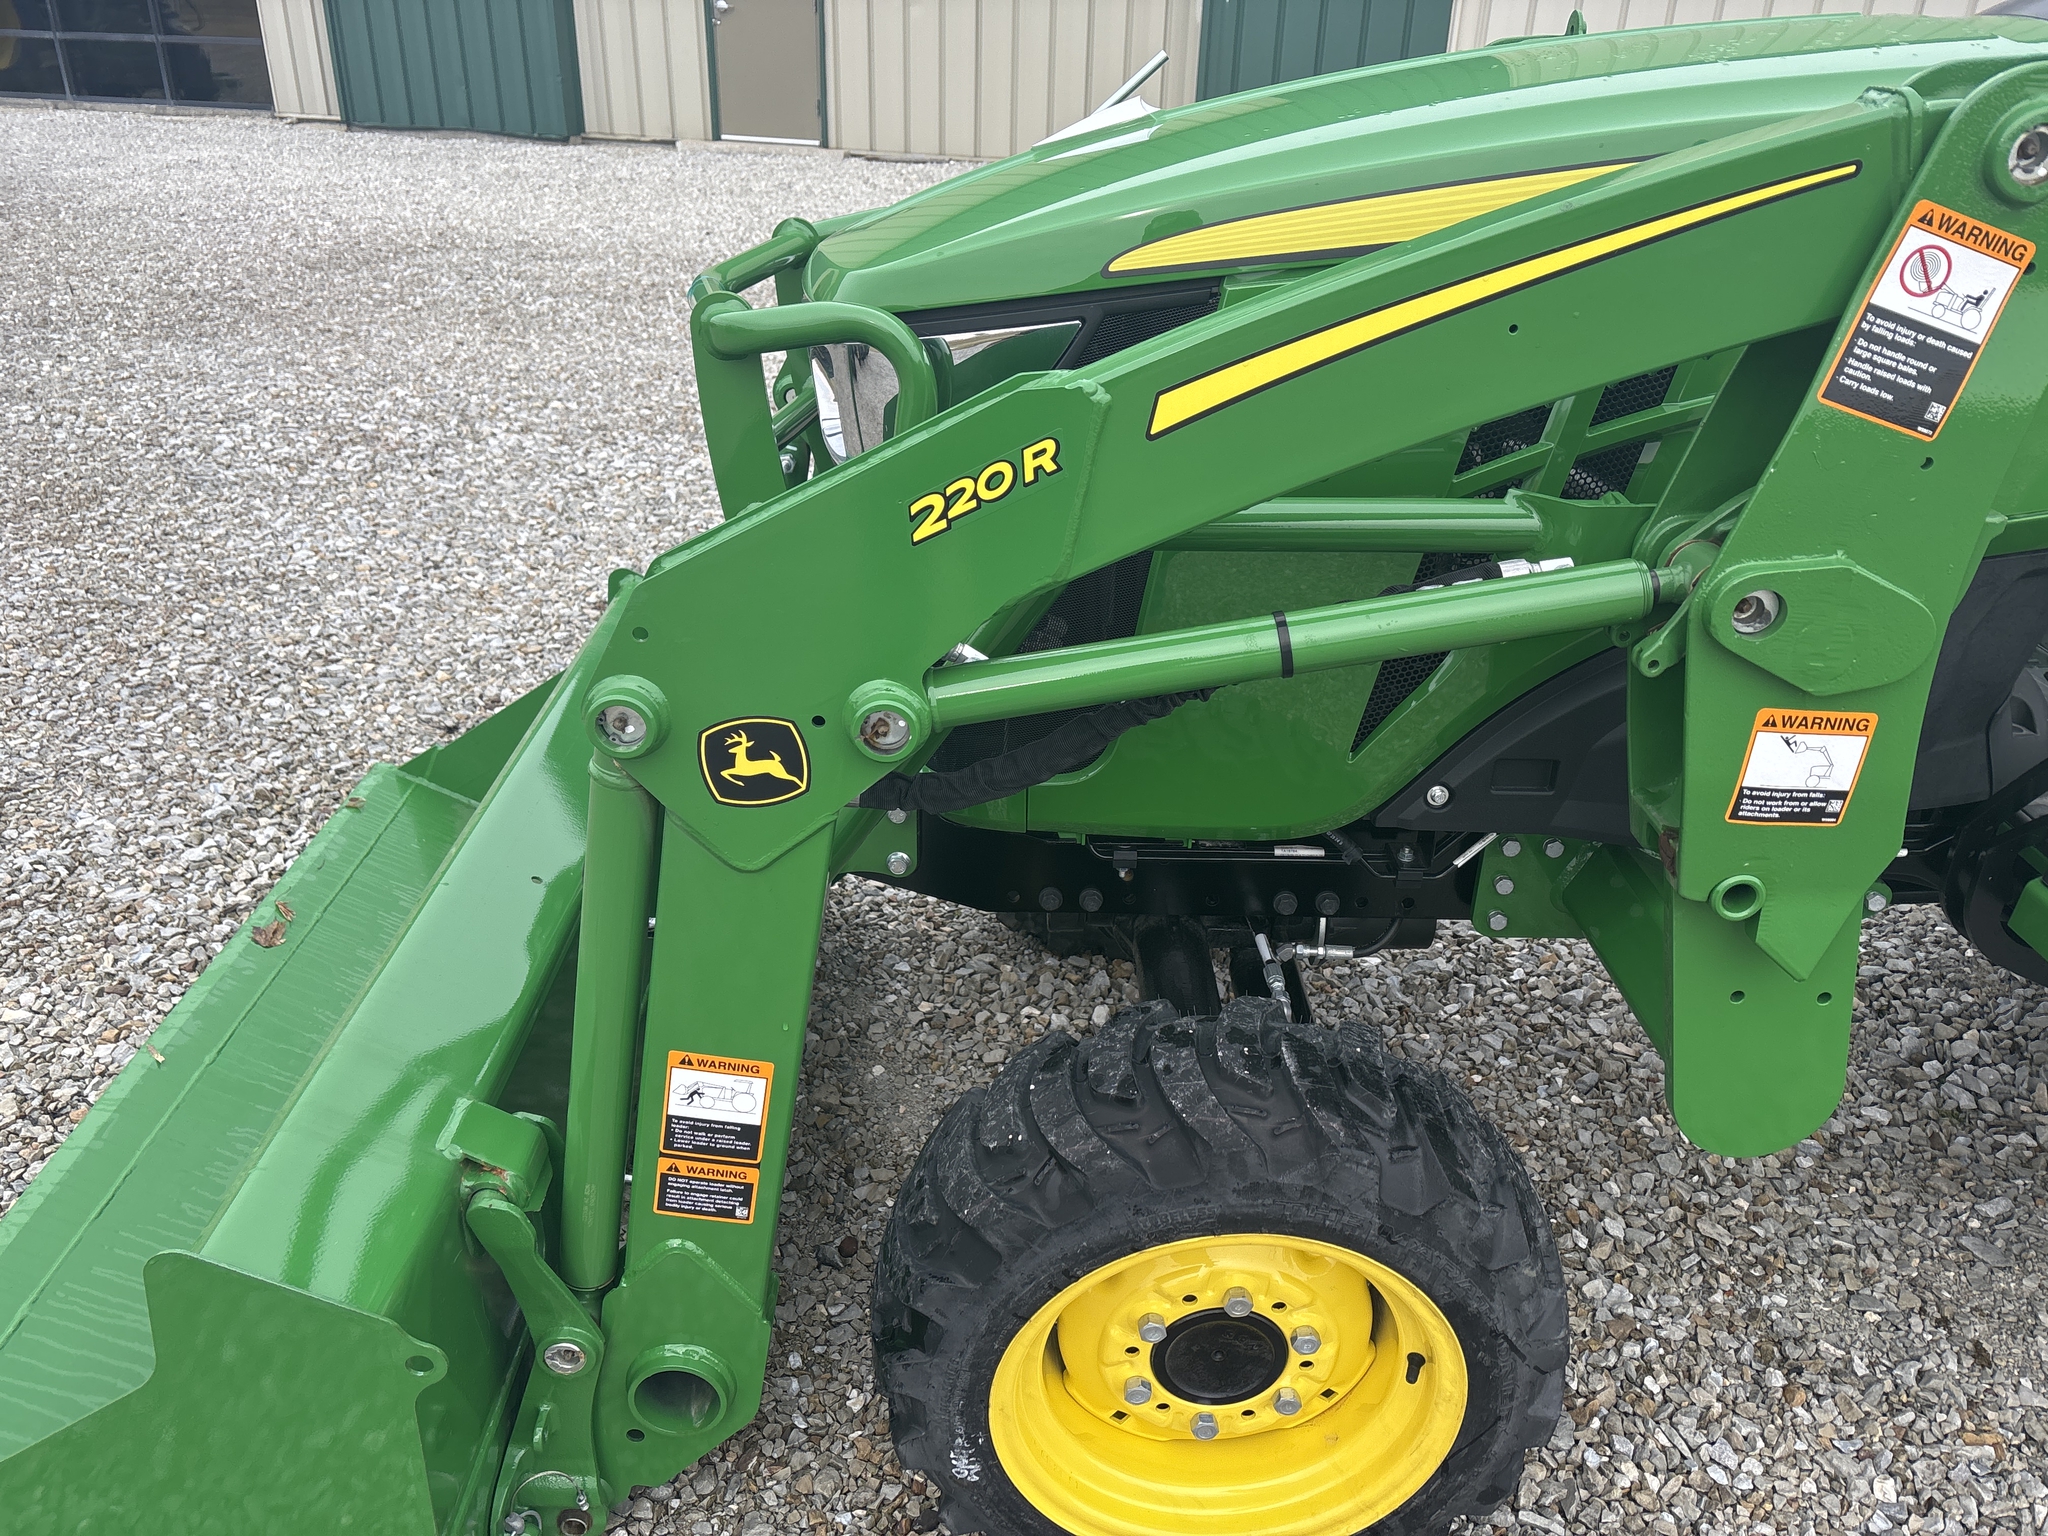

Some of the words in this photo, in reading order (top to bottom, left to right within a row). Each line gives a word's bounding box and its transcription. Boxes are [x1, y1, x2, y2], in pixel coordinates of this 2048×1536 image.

[1938, 212, 2028, 263] WARNING
[1861, 322, 1871, 331] by
[1871, 325, 1894, 340] falling
[1894, 334, 1917, 347] loads:
[1866, 313, 1875, 322] To
[1875, 317, 1896, 329] avoid
[1896, 325, 1916, 339] injury
[1926, 336, 1946, 349] death
[1947, 345, 1973, 359] caused
[1853, 346, 1872, 359] large
[1873, 353, 1896, 368] square
[1897, 362, 1918, 375] bales.
[1857, 337, 1868, 346] Do
[1869, 342, 1882, 352] not
[1882, 346, 1906, 362] handle
[1906, 357, 1927, 369] round
[1928, 365, 1937, 373] or
[1844, 367, 1871, 381] caution.
[1848, 358, 1873, 372] Handle
[1874, 366, 1895, 380] raised
[1896, 375, 1916, 388] loads
[1917, 382, 1932, 394] with
[1839, 375, 1859, 389] Carry
[1859, 384, 1879, 396] loads
[1880, 390, 1894, 401] low.
[1781, 715, 1870, 732] WARNING
[697, 1058, 760, 1074] WARNING
[686, 1165, 747, 1180] WARNING
